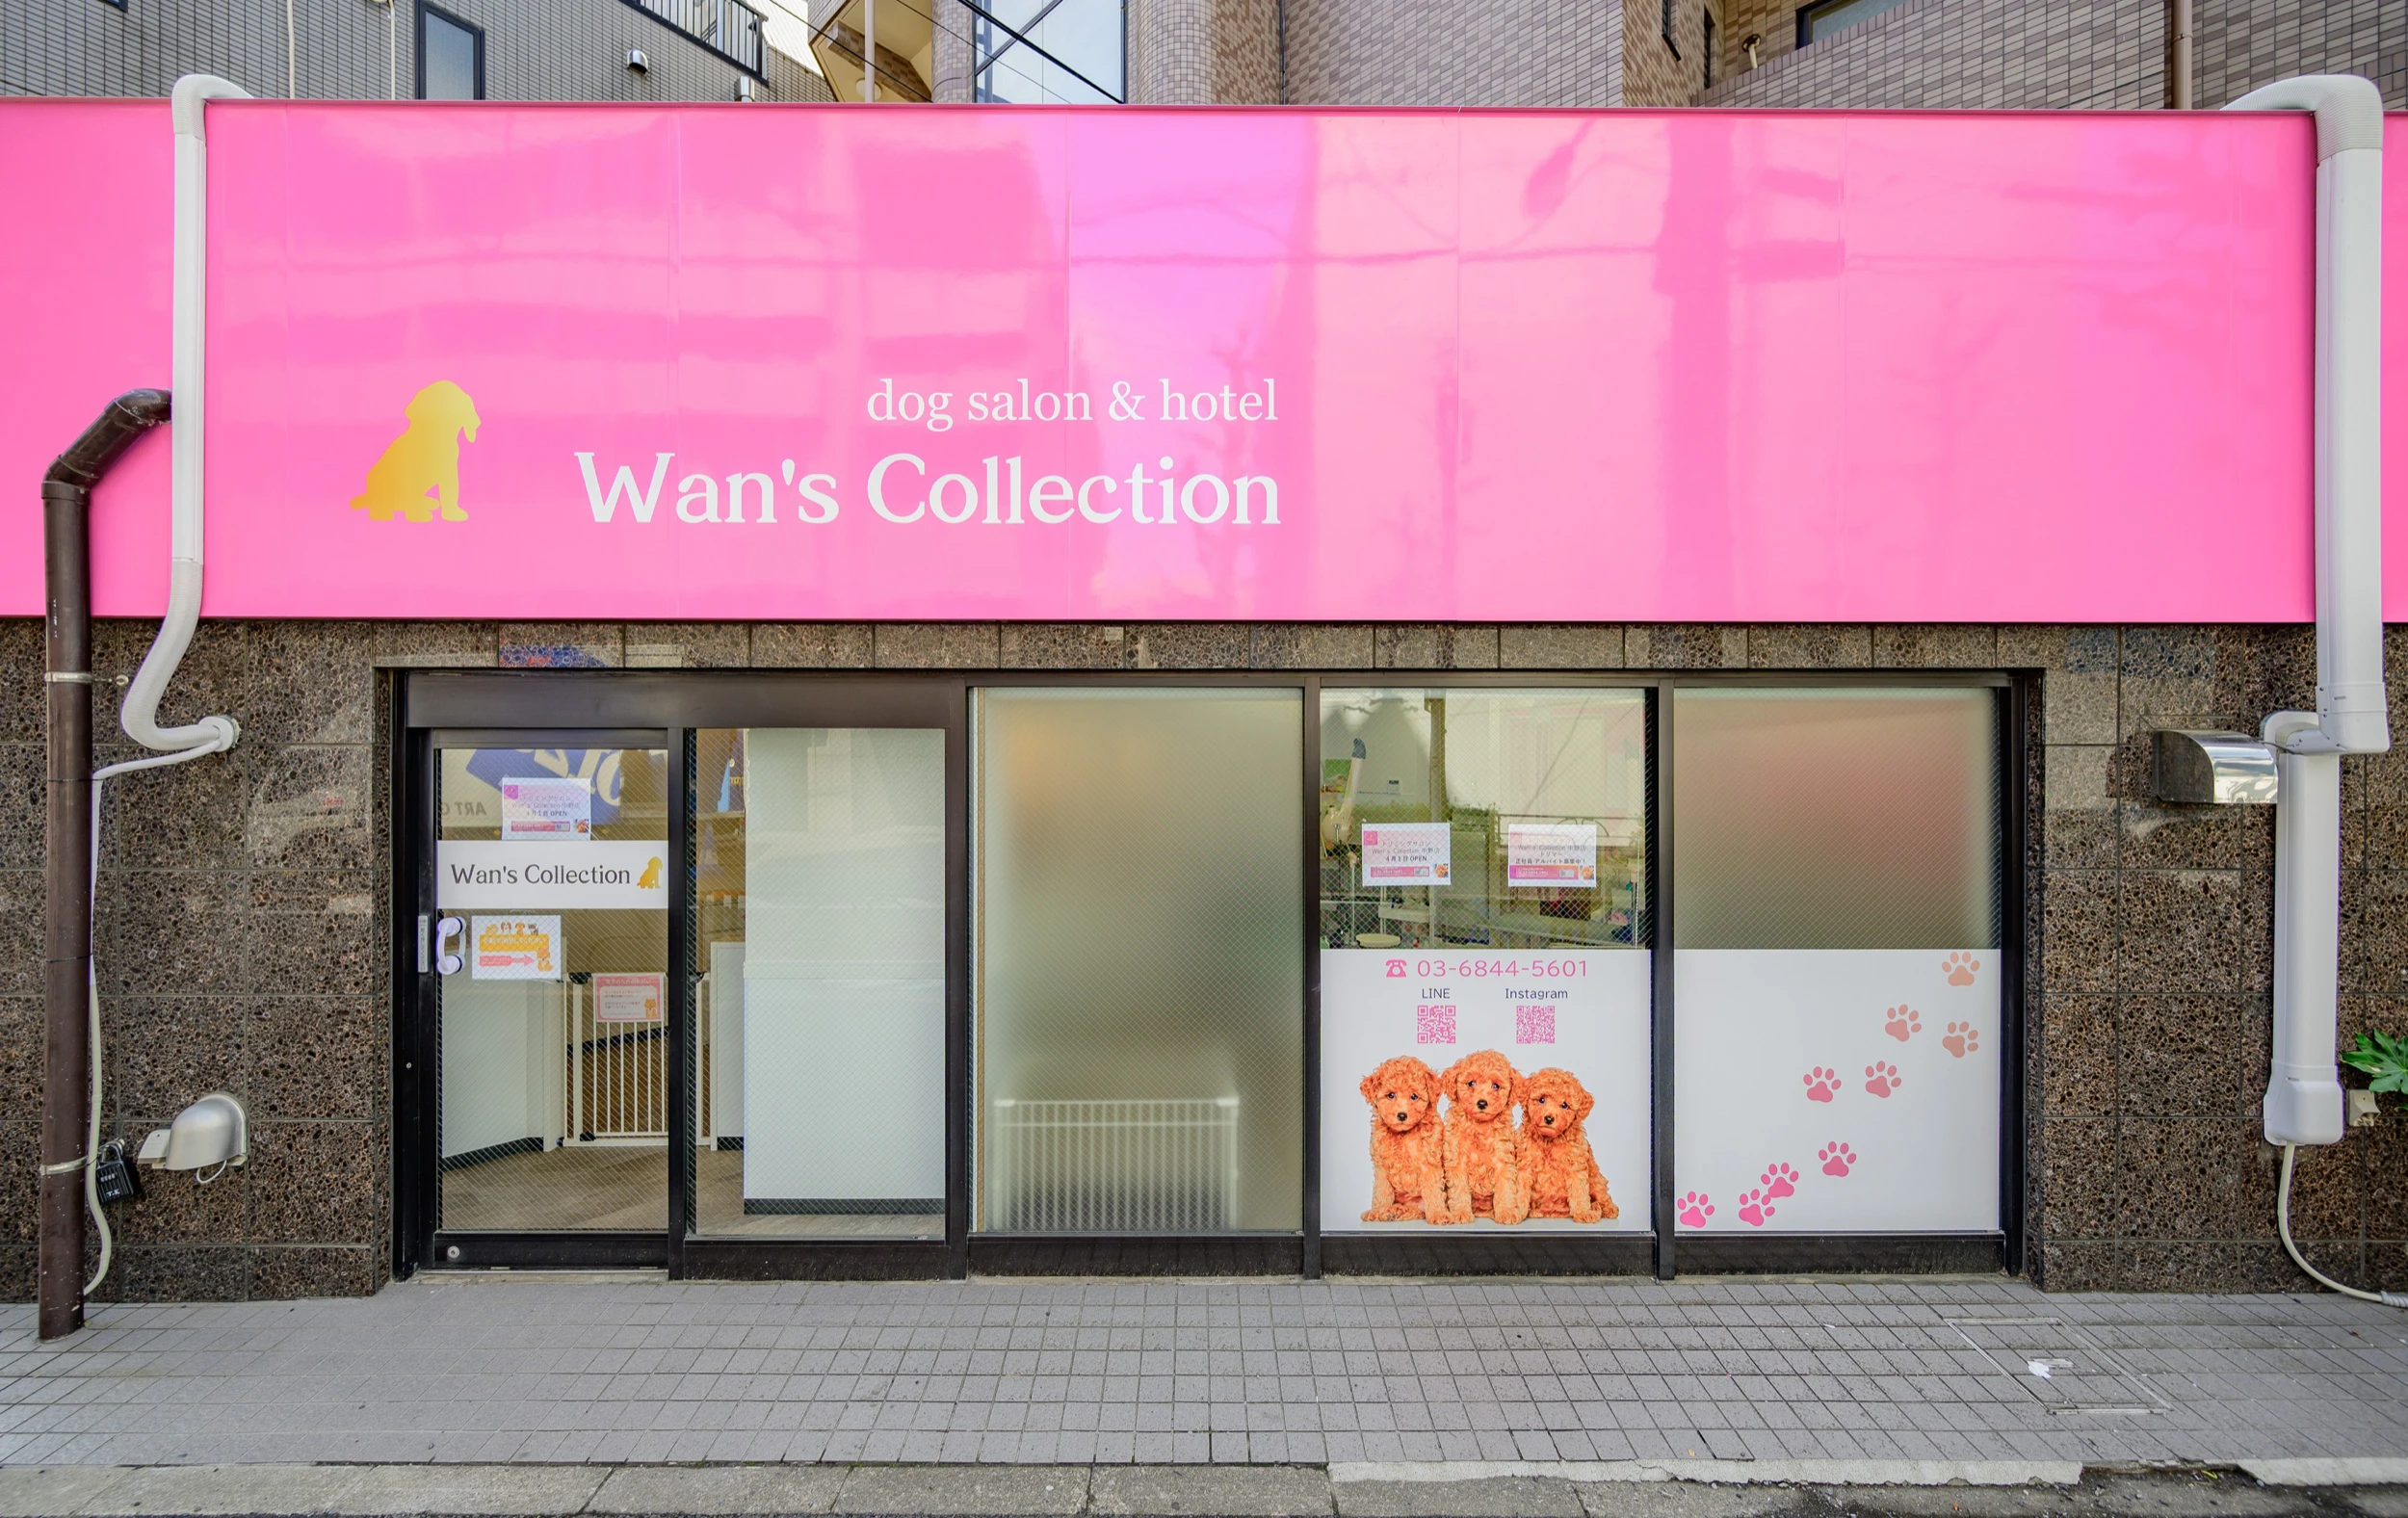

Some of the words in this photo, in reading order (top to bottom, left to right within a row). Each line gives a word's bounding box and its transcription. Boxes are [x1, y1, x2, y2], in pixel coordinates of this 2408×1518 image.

[867, 380, 955, 432] dog
[968, 379, 1092, 422] salon
[1109, 381, 1146, 422] &
[1160, 379, 1279, 422] hotel
[575, 453, 841, 526] Wan's
[867, 453, 1282, 526] Collection
[450, 863, 518, 884] Wan's
[524, 863, 631, 884] Collection
[1417, 959, 1587, 978] 03-6844-5601
[1422, 987, 1451, 999] LINE
[1505, 987, 1568, 1001] Instagram
